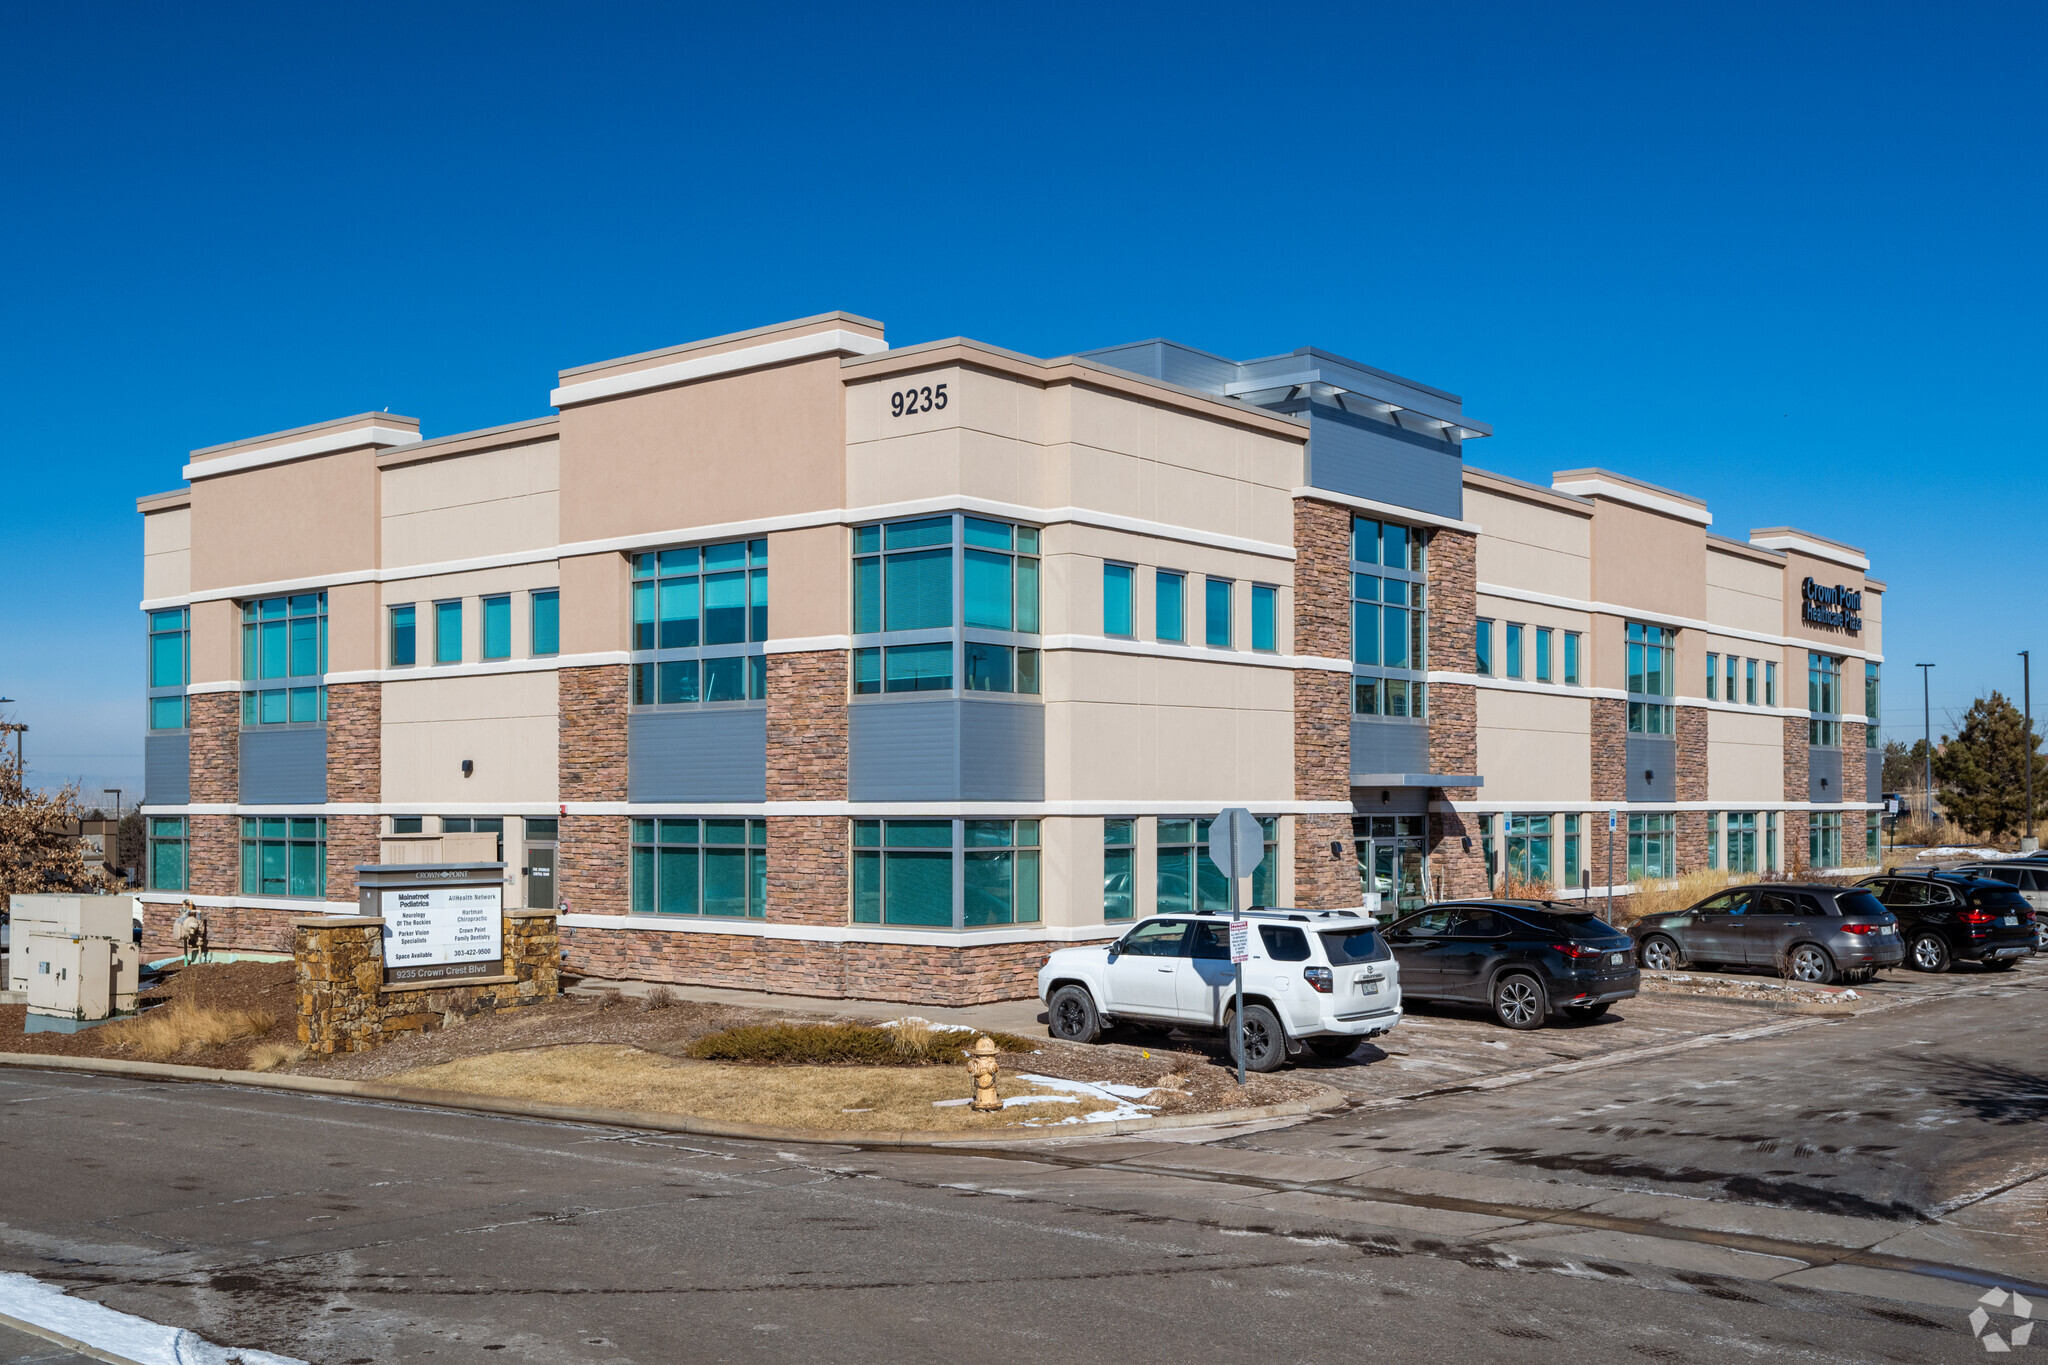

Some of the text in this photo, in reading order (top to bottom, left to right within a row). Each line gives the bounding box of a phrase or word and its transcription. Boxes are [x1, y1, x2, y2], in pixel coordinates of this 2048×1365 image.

[891, 383, 948, 418] 9235
[1803, 576, 1862, 611] Crown Point
[1803, 600, 1862, 631] Healthcare Plaza
[415, 870, 468, 879] CROWN POINT
[398, 893, 429, 901] Mainstreet
[399, 900, 429, 908] Pediatrics
[401, 937, 427, 945] Specialists
[470, 933, 490, 941] Dentistry
[454, 948, 491, 957] 303-422-9500
[396, 964, 486, 979] 9235 Crown Crest Blvd
